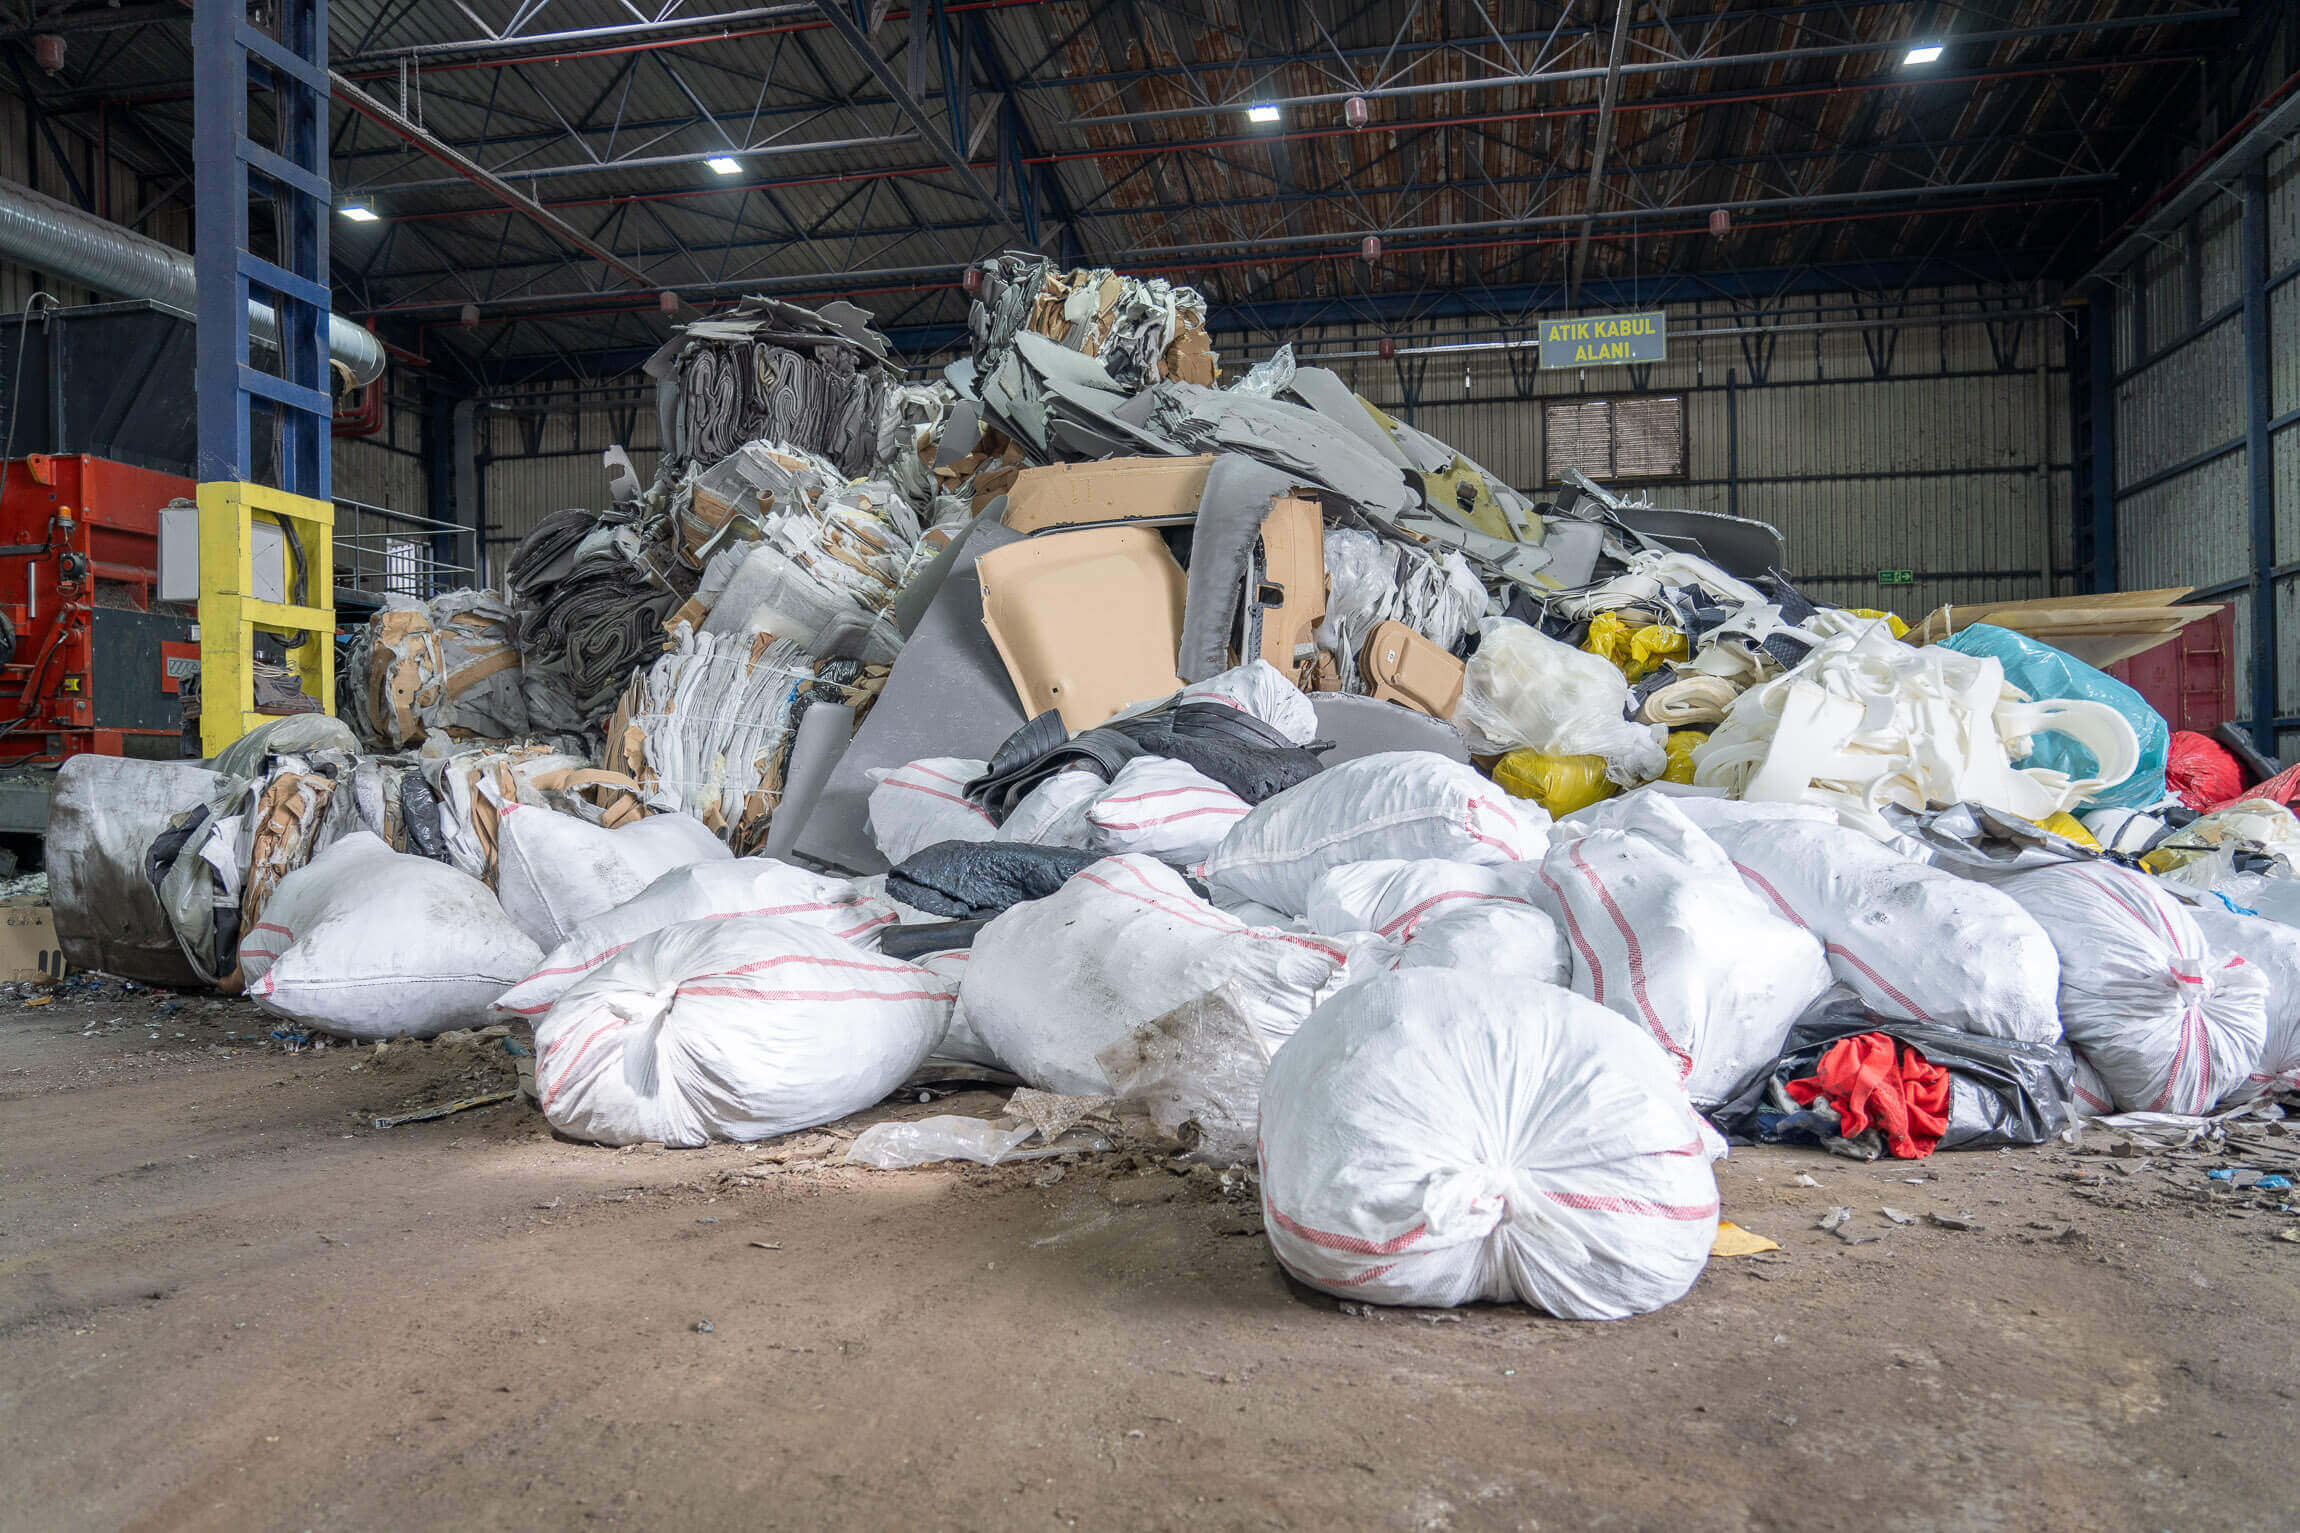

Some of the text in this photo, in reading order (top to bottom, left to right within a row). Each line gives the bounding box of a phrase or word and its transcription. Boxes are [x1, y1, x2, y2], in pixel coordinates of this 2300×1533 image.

[1549, 318, 1656, 342] ATIK KABUL
[1575, 342, 1630, 361] ALANI
